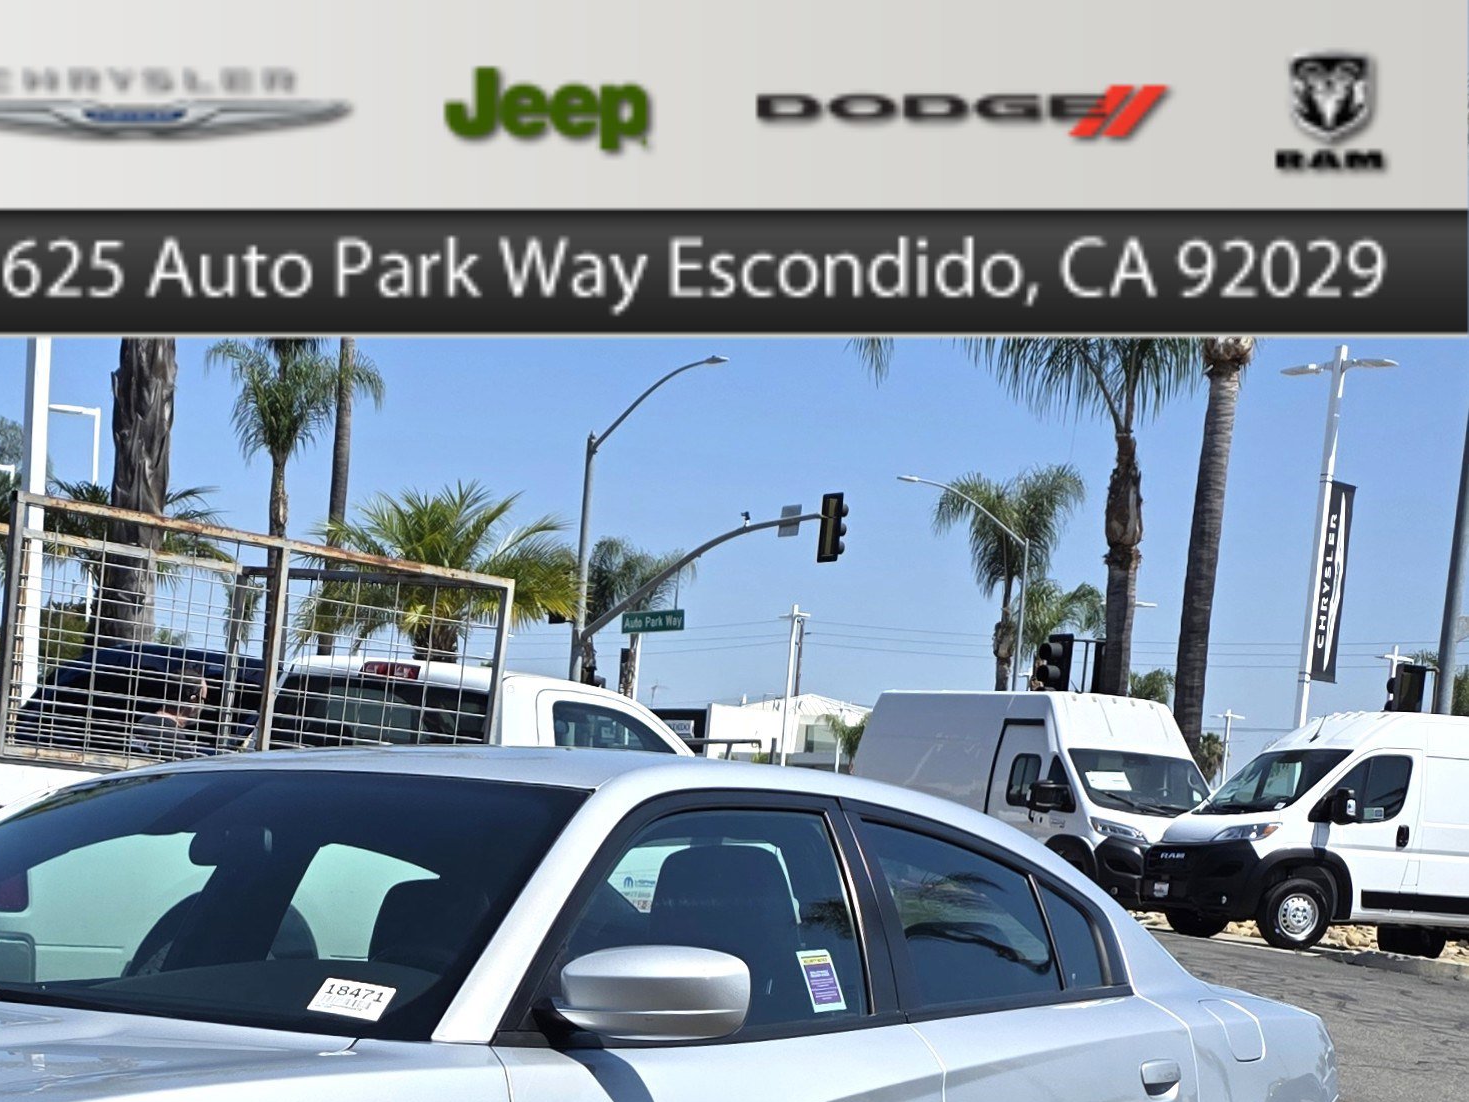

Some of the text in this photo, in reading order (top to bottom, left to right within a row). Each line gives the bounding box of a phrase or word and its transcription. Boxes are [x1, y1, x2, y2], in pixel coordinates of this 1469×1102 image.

[1317, 513, 1338, 649] CHRYSLER
[624, 615, 682, 628] Auto Park Way
[325, 983, 384, 1003] 18471
